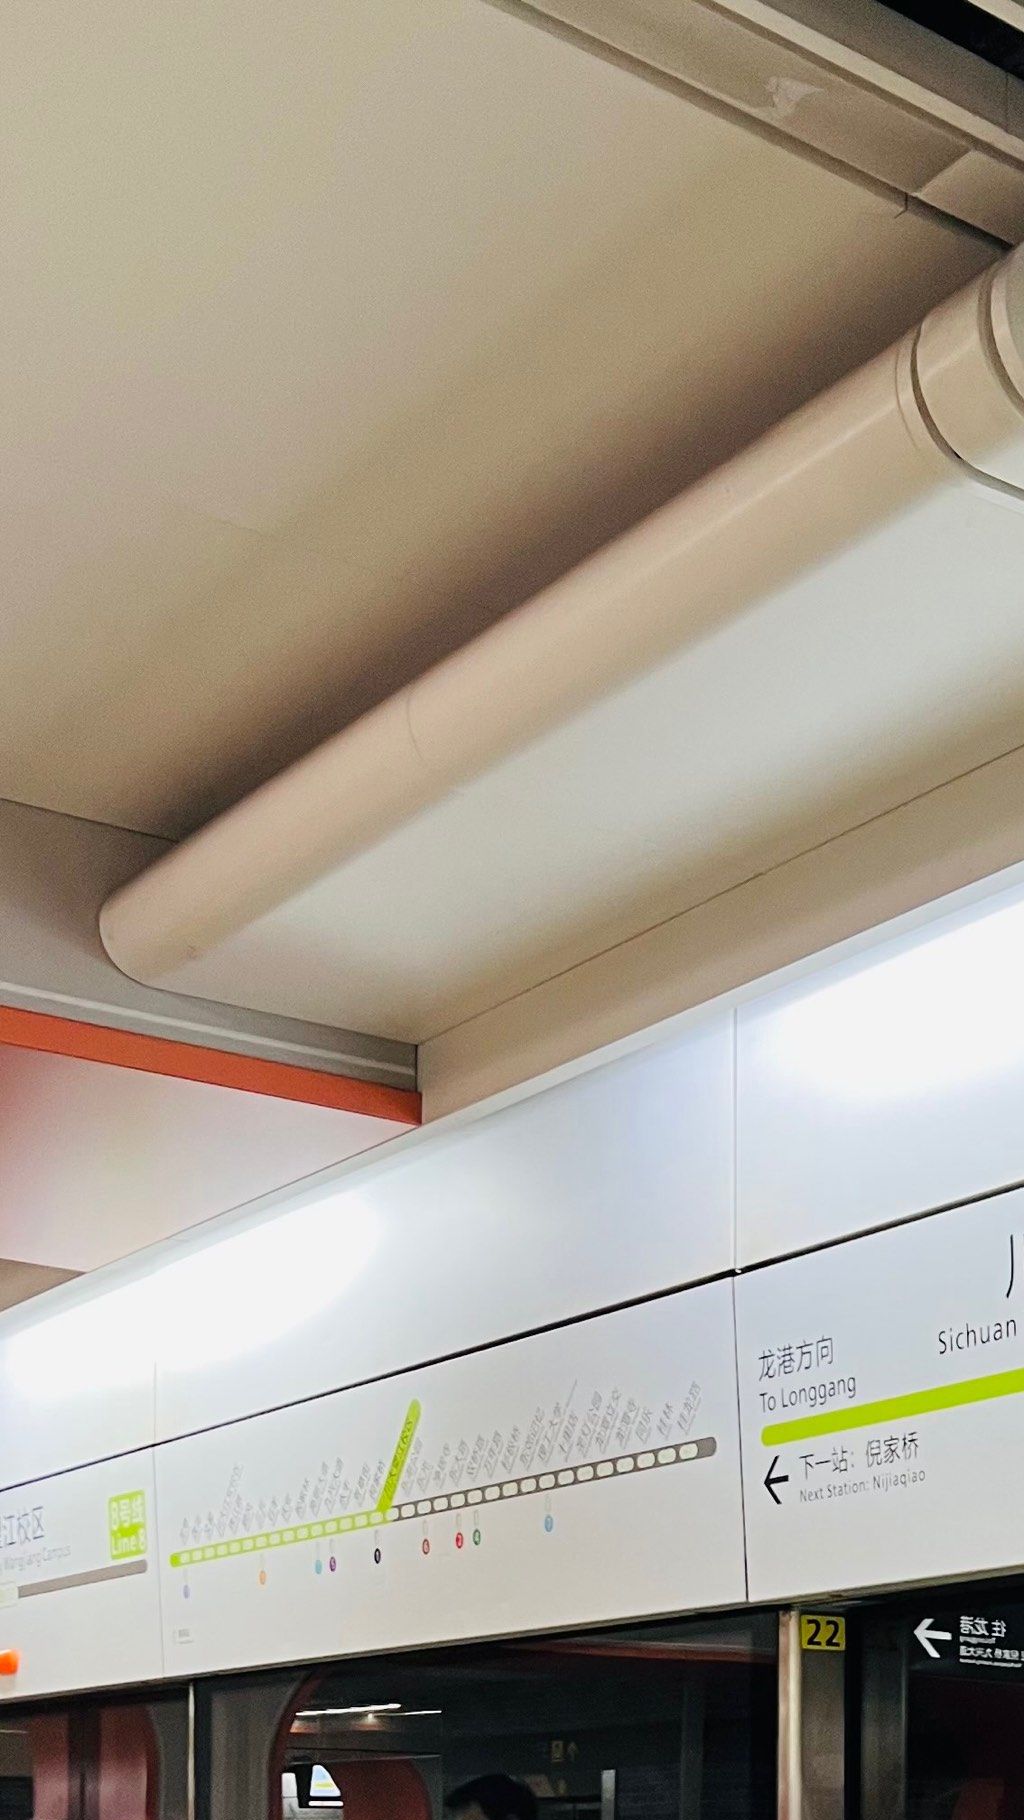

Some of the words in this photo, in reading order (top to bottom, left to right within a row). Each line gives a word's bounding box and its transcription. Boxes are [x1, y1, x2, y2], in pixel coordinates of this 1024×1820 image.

[938, 1317, 1017, 1354] Sichuan
[758, 1335, 834, 1381] 龙港方向
[759, 1392, 776, 1412] To
[781, 1376, 856, 1409] Longgang
[800, 1488, 823, 1502] Next
[827, 1481, 869, 1498] Station:
[873, 1469, 926, 1492] Nijiaqiao
[806, 1619, 840, 1647] 22
